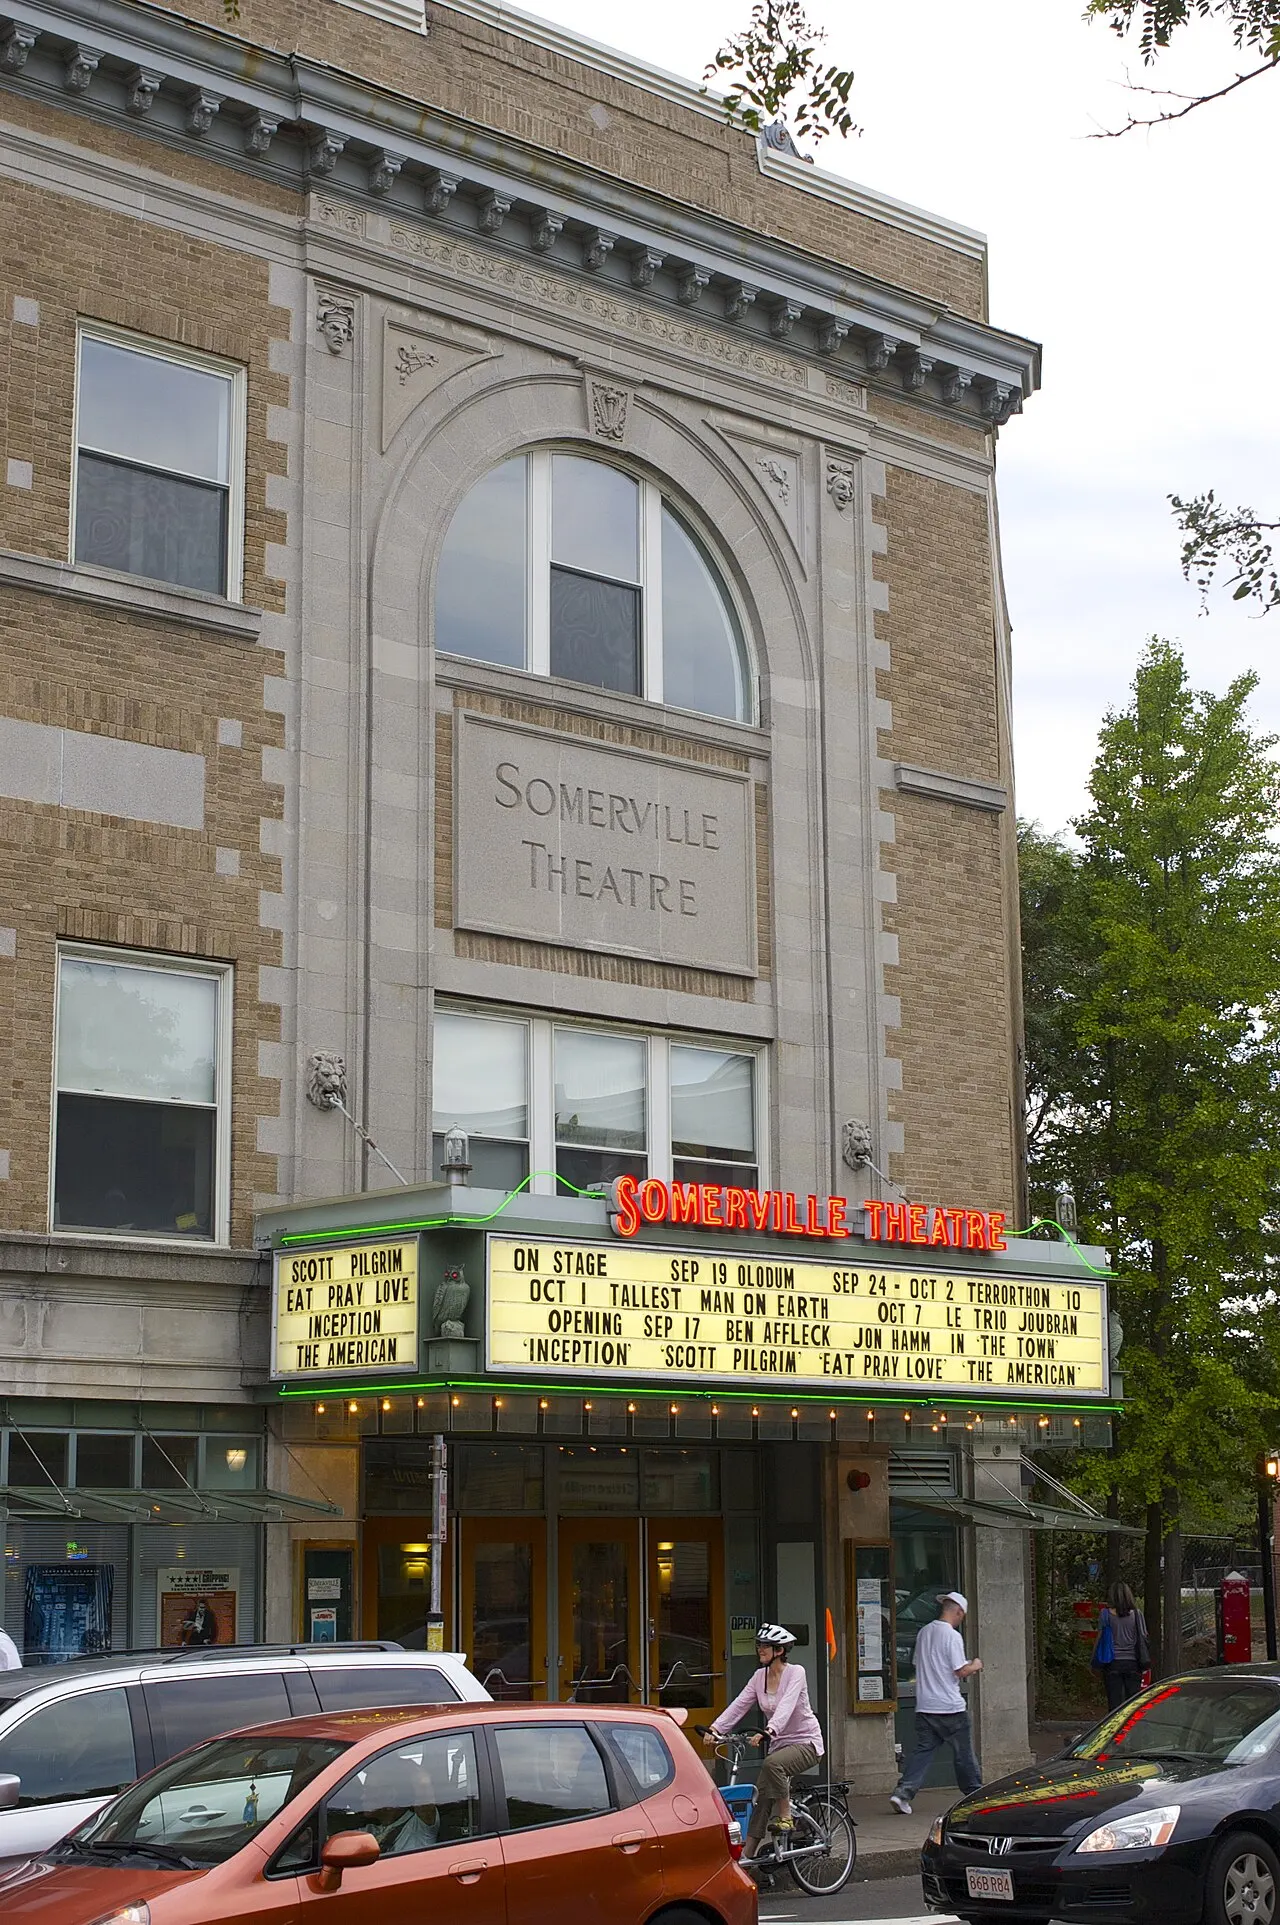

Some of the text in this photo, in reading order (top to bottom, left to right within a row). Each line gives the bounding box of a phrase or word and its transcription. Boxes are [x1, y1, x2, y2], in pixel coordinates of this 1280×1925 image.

[495, 762, 720, 851] SOMERVILLE
[521, 840, 698, 917] THEATRE
[613, 1174, 1007, 1252] SOMERVILLE THEATRE
[292, 1248, 402, 1283] SCOTT PILGRIM
[514, 1248, 539, 1272] ON
[553, 1251, 607, 1276] STAGE
[670, 1259, 700, 1282] SEP
[712, 1262, 727, 1285] 19
[737, 1264, 794, 1289] OLODUM
[833, 1271, 859, 1294] SEP
[869, 1274, 887, 1294] 24
[910, 1278, 936, 1300] OCT
[946, 1280, 954, 1301] 2
[967, 1281, 1049, 1308] TERRORTHON
[287, 1277, 409, 1312] EAT PRAY LOVE
[530, 1279, 566, 1304] OCT
[610, 1283, 681, 1309] TALLEST
[701, 1289, 733, 1314] MAN
[744, 1292, 766, 1315] ON
[778, 1294, 828, 1319] EARTH
[878, 1301, 904, 1323] OCT
[915, 1304, 922, 1324] 7
[946, 1306, 961, 1328] LE
[974, 1308, 1006, 1330] TRIO
[1019, 1311, 1077, 1335] JOUBRAN
[308, 1310, 381, 1339] INCEPTION
[548, 1310, 622, 1335] OPENING
[644, 1315, 673, 1338] SEP
[685, 1317, 700, 1340] 17
[727, 1320, 753, 1342] BEN
[764, 1322, 830, 1347] AFFLECK
[854, 1328, 882, 1349] JON
[892, 1329, 930, 1351] HAMM
[951, 1333, 964, 1353] IN
[297, 1338, 397, 1368] THE AMERICAN
[864, 1355, 898, 1379] PRAY
[731, 1617, 755, 1630] OPEN
